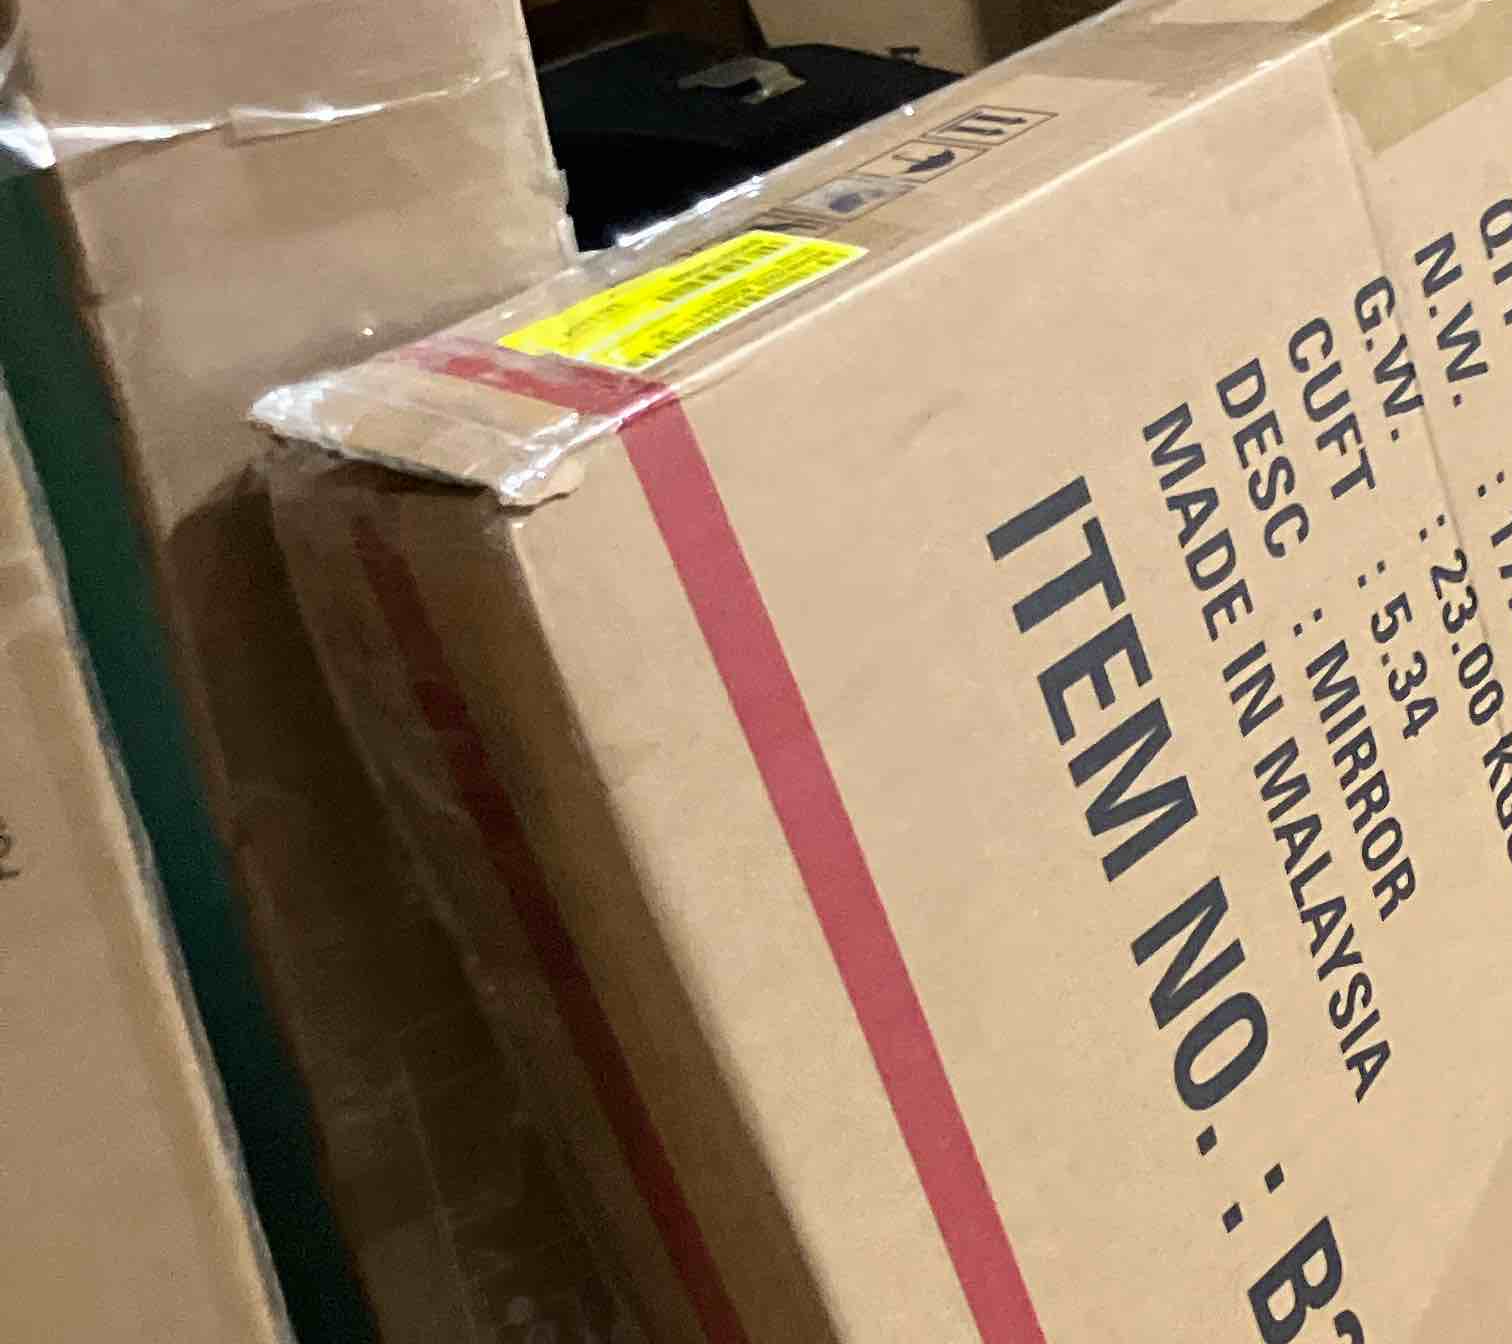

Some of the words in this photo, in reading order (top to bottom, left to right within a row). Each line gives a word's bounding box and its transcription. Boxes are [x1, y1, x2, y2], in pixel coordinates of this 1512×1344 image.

[1354, 274, 1425, 442] G.W.
[1430, 547, 1505, 727] 23.00
[1413, 231, 1490, 409] N.W.
[986, 475, 1198, 883] ITEM
[1142, 402, 1254, 643] MADE
[1216, 357, 1310, 559] DESC
[1305, 639, 1417, 923] MIRROR
[1222, 641, 1284, 738] IN
[1288, 316, 1377, 501] CUFT
[1371, 592, 1440, 741] 5.34
[1252, 736, 1392, 1104] MALAYSIA
